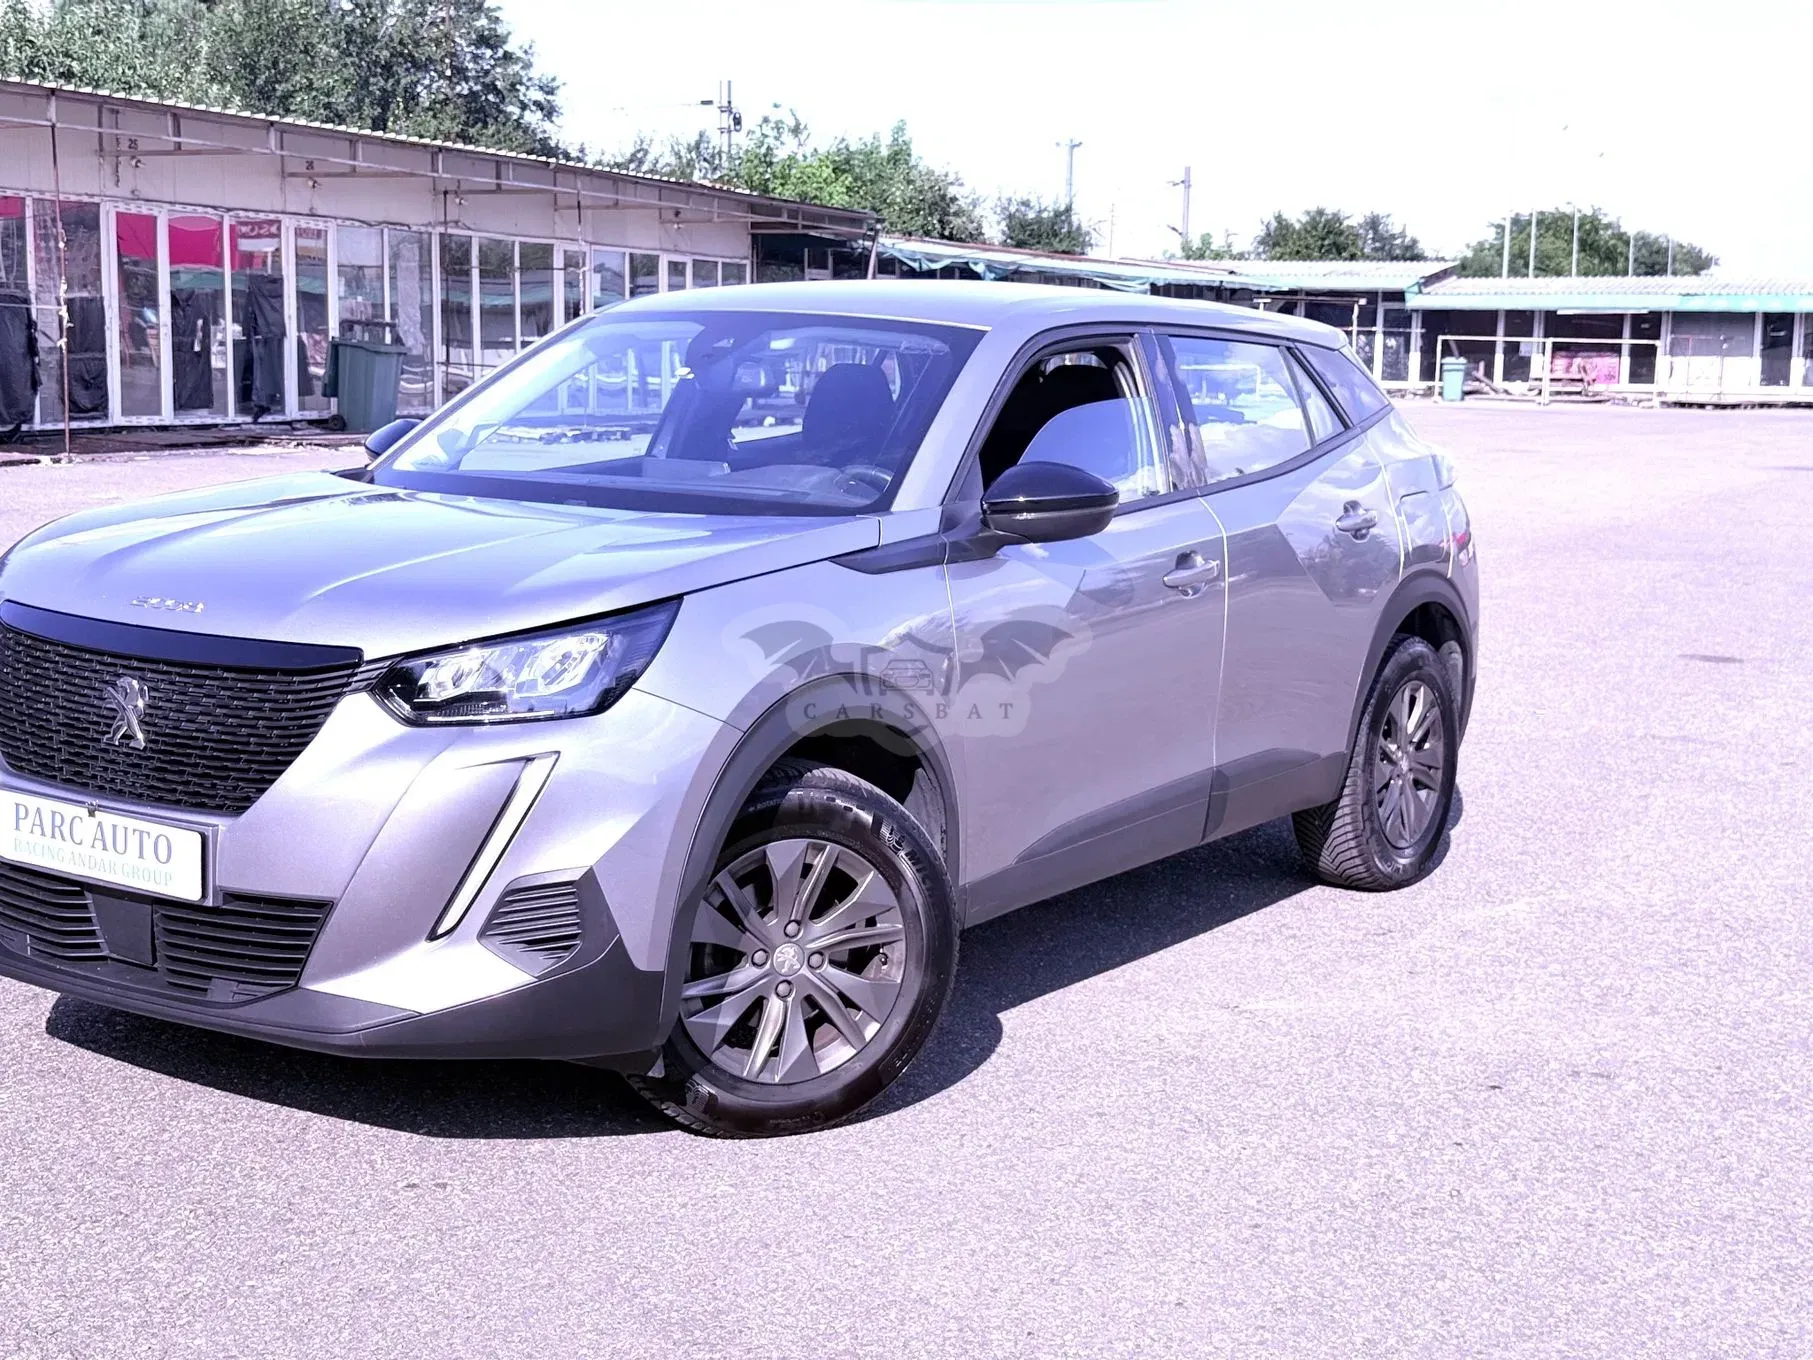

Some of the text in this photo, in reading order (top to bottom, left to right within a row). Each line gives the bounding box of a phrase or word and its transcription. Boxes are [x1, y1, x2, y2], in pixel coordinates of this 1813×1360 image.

[14, 802, 173, 865] PARC AUTO
[14, 837, 65, 864] RACING
[121, 862, 174, 887] GROUP
